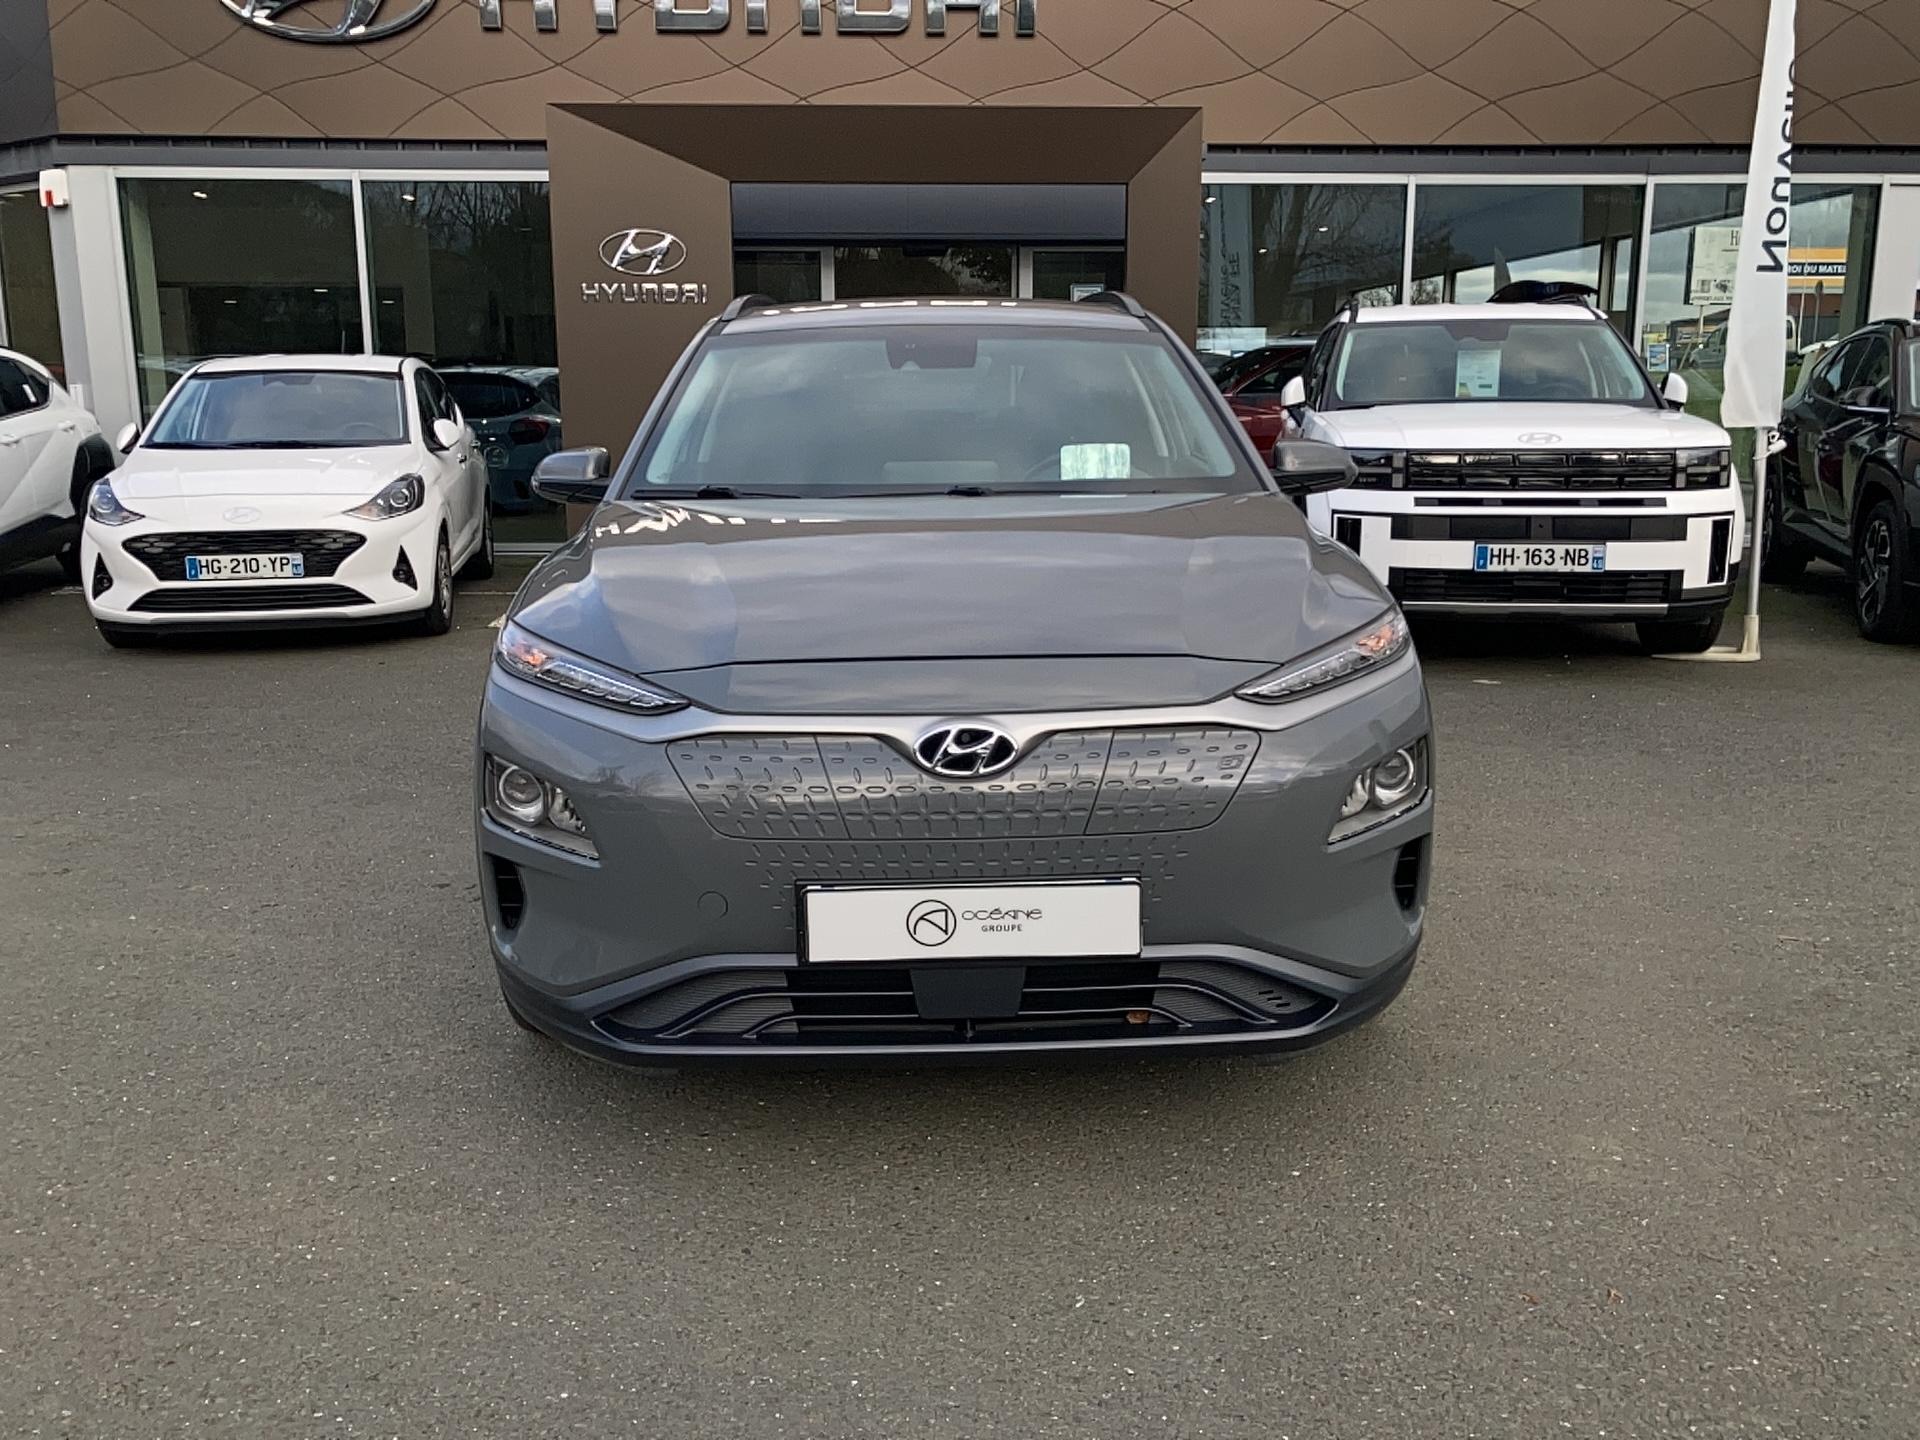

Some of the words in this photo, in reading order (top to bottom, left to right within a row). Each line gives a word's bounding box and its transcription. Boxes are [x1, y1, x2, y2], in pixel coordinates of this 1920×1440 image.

[581, 282, 707, 304] HYUNDAI
[198, 556, 290, 575] HG-210-YP
[1489, 547, 1589, 566] HH-163-NB
[981, 924, 1022, 932] GROUPE
